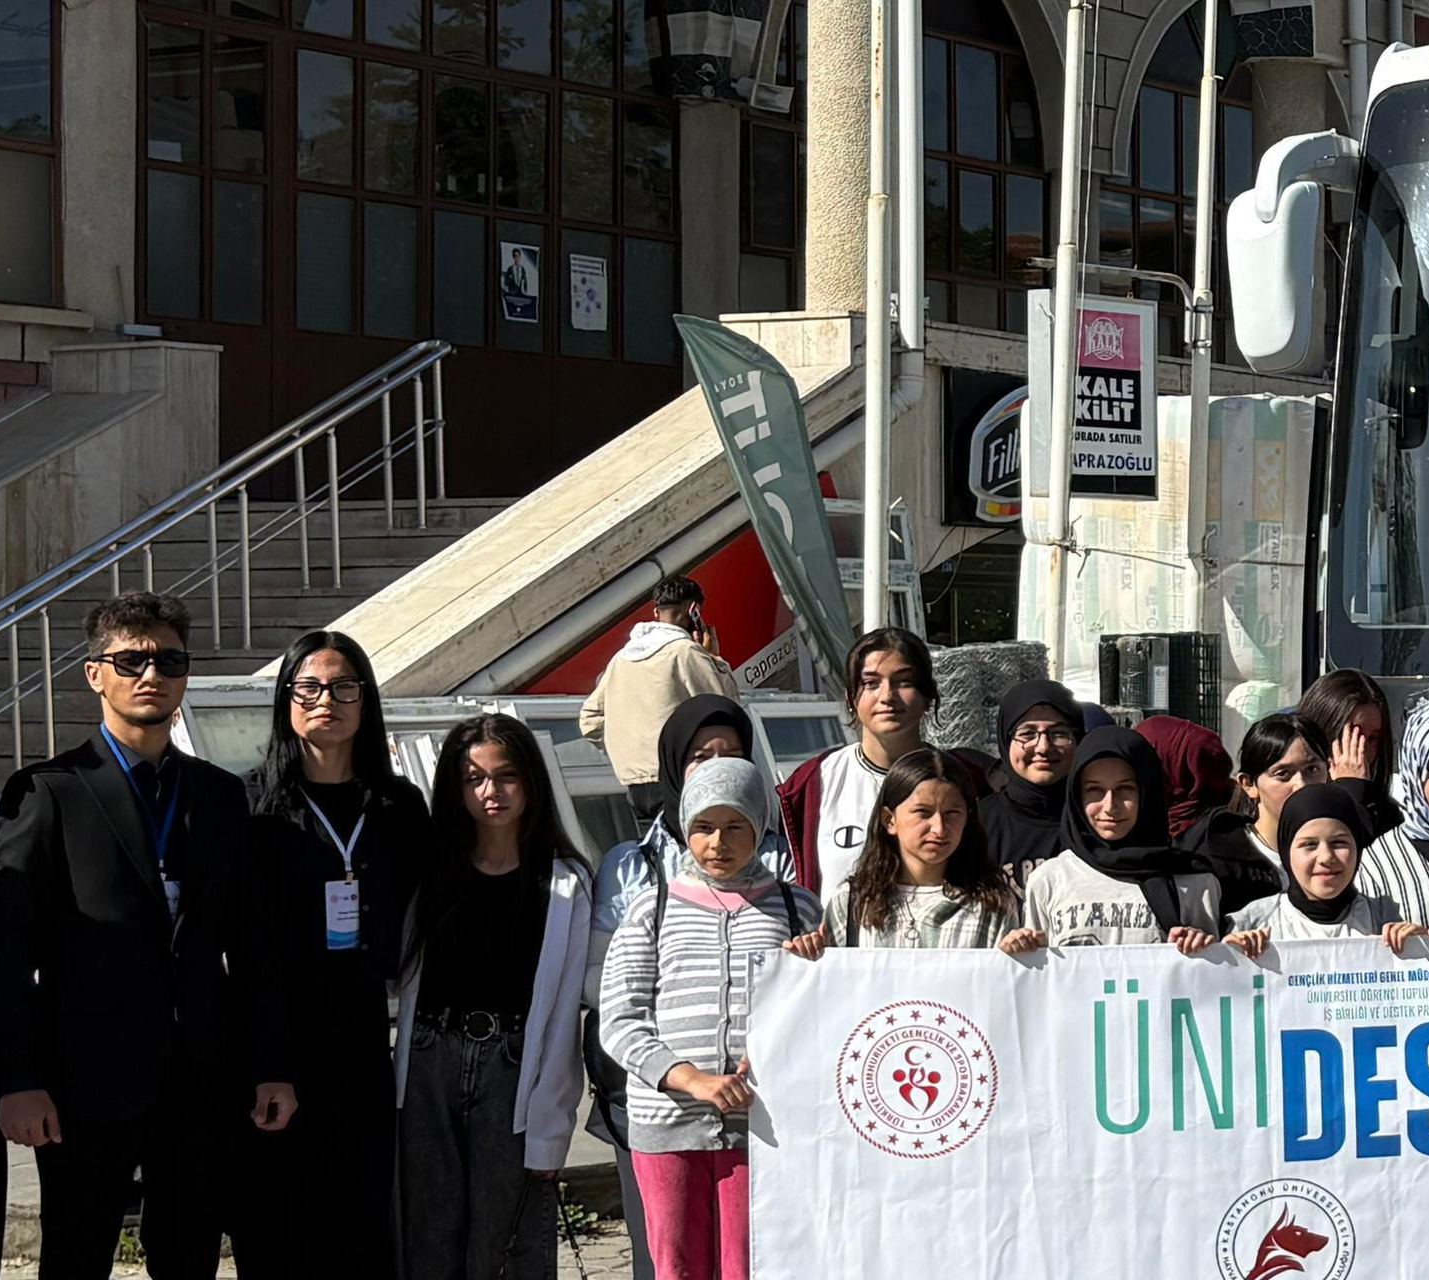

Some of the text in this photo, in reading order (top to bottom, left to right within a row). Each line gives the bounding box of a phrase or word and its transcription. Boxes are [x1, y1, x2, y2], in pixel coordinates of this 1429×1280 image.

[1084, 324, 1125, 359] KALE
[1077, 375, 1134, 399] KALE
[1072, 431, 1106, 443] URADA
[1288, 973, 1326, 987] GENÇLİK
[1327, 969, 1378, 986] HİZMETLERİ
[1379, 970, 1405, 983] GENEL
[1371, 1007, 1380, 1019] VE
[1383, 1005, 1415, 1019] DESTEK
[866, 1030, 969, 1128] TÜRKİYE CUMHURİYETİ GENÇLİK VE SPOR BAKANLIĞI
[1221, 1182, 1350, 1244] KASTAMONU ÜNİVERSİTESİ
